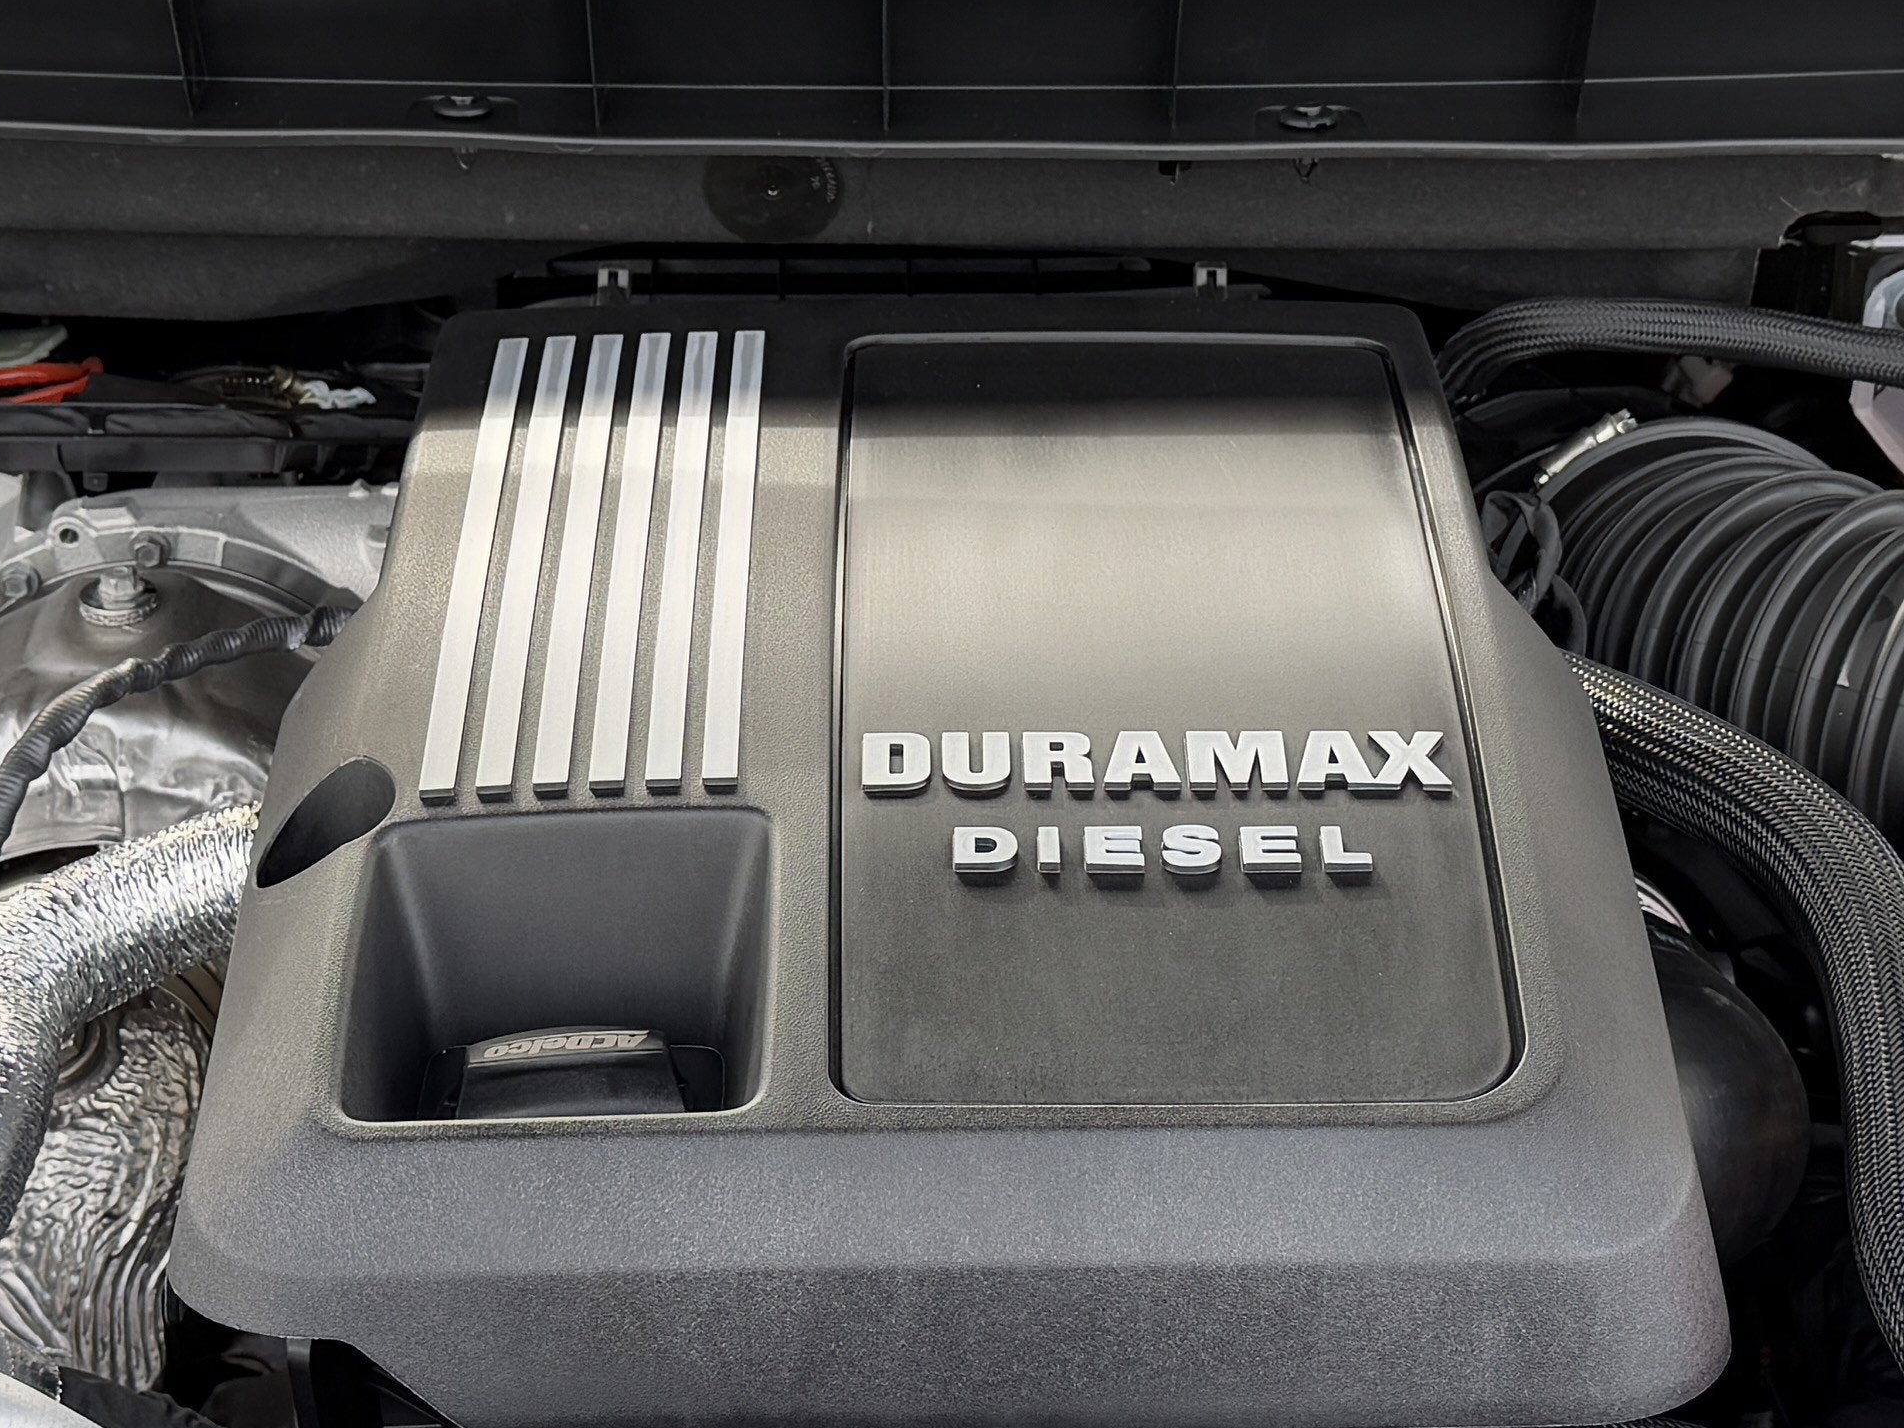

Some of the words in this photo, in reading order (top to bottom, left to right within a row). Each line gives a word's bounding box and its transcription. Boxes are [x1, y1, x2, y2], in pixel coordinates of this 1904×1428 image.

[862, 730, 1453, 793] DURAMAX
[953, 824, 1373, 876] DIESEL
[483, 1029, 649, 1059] ACDelco
